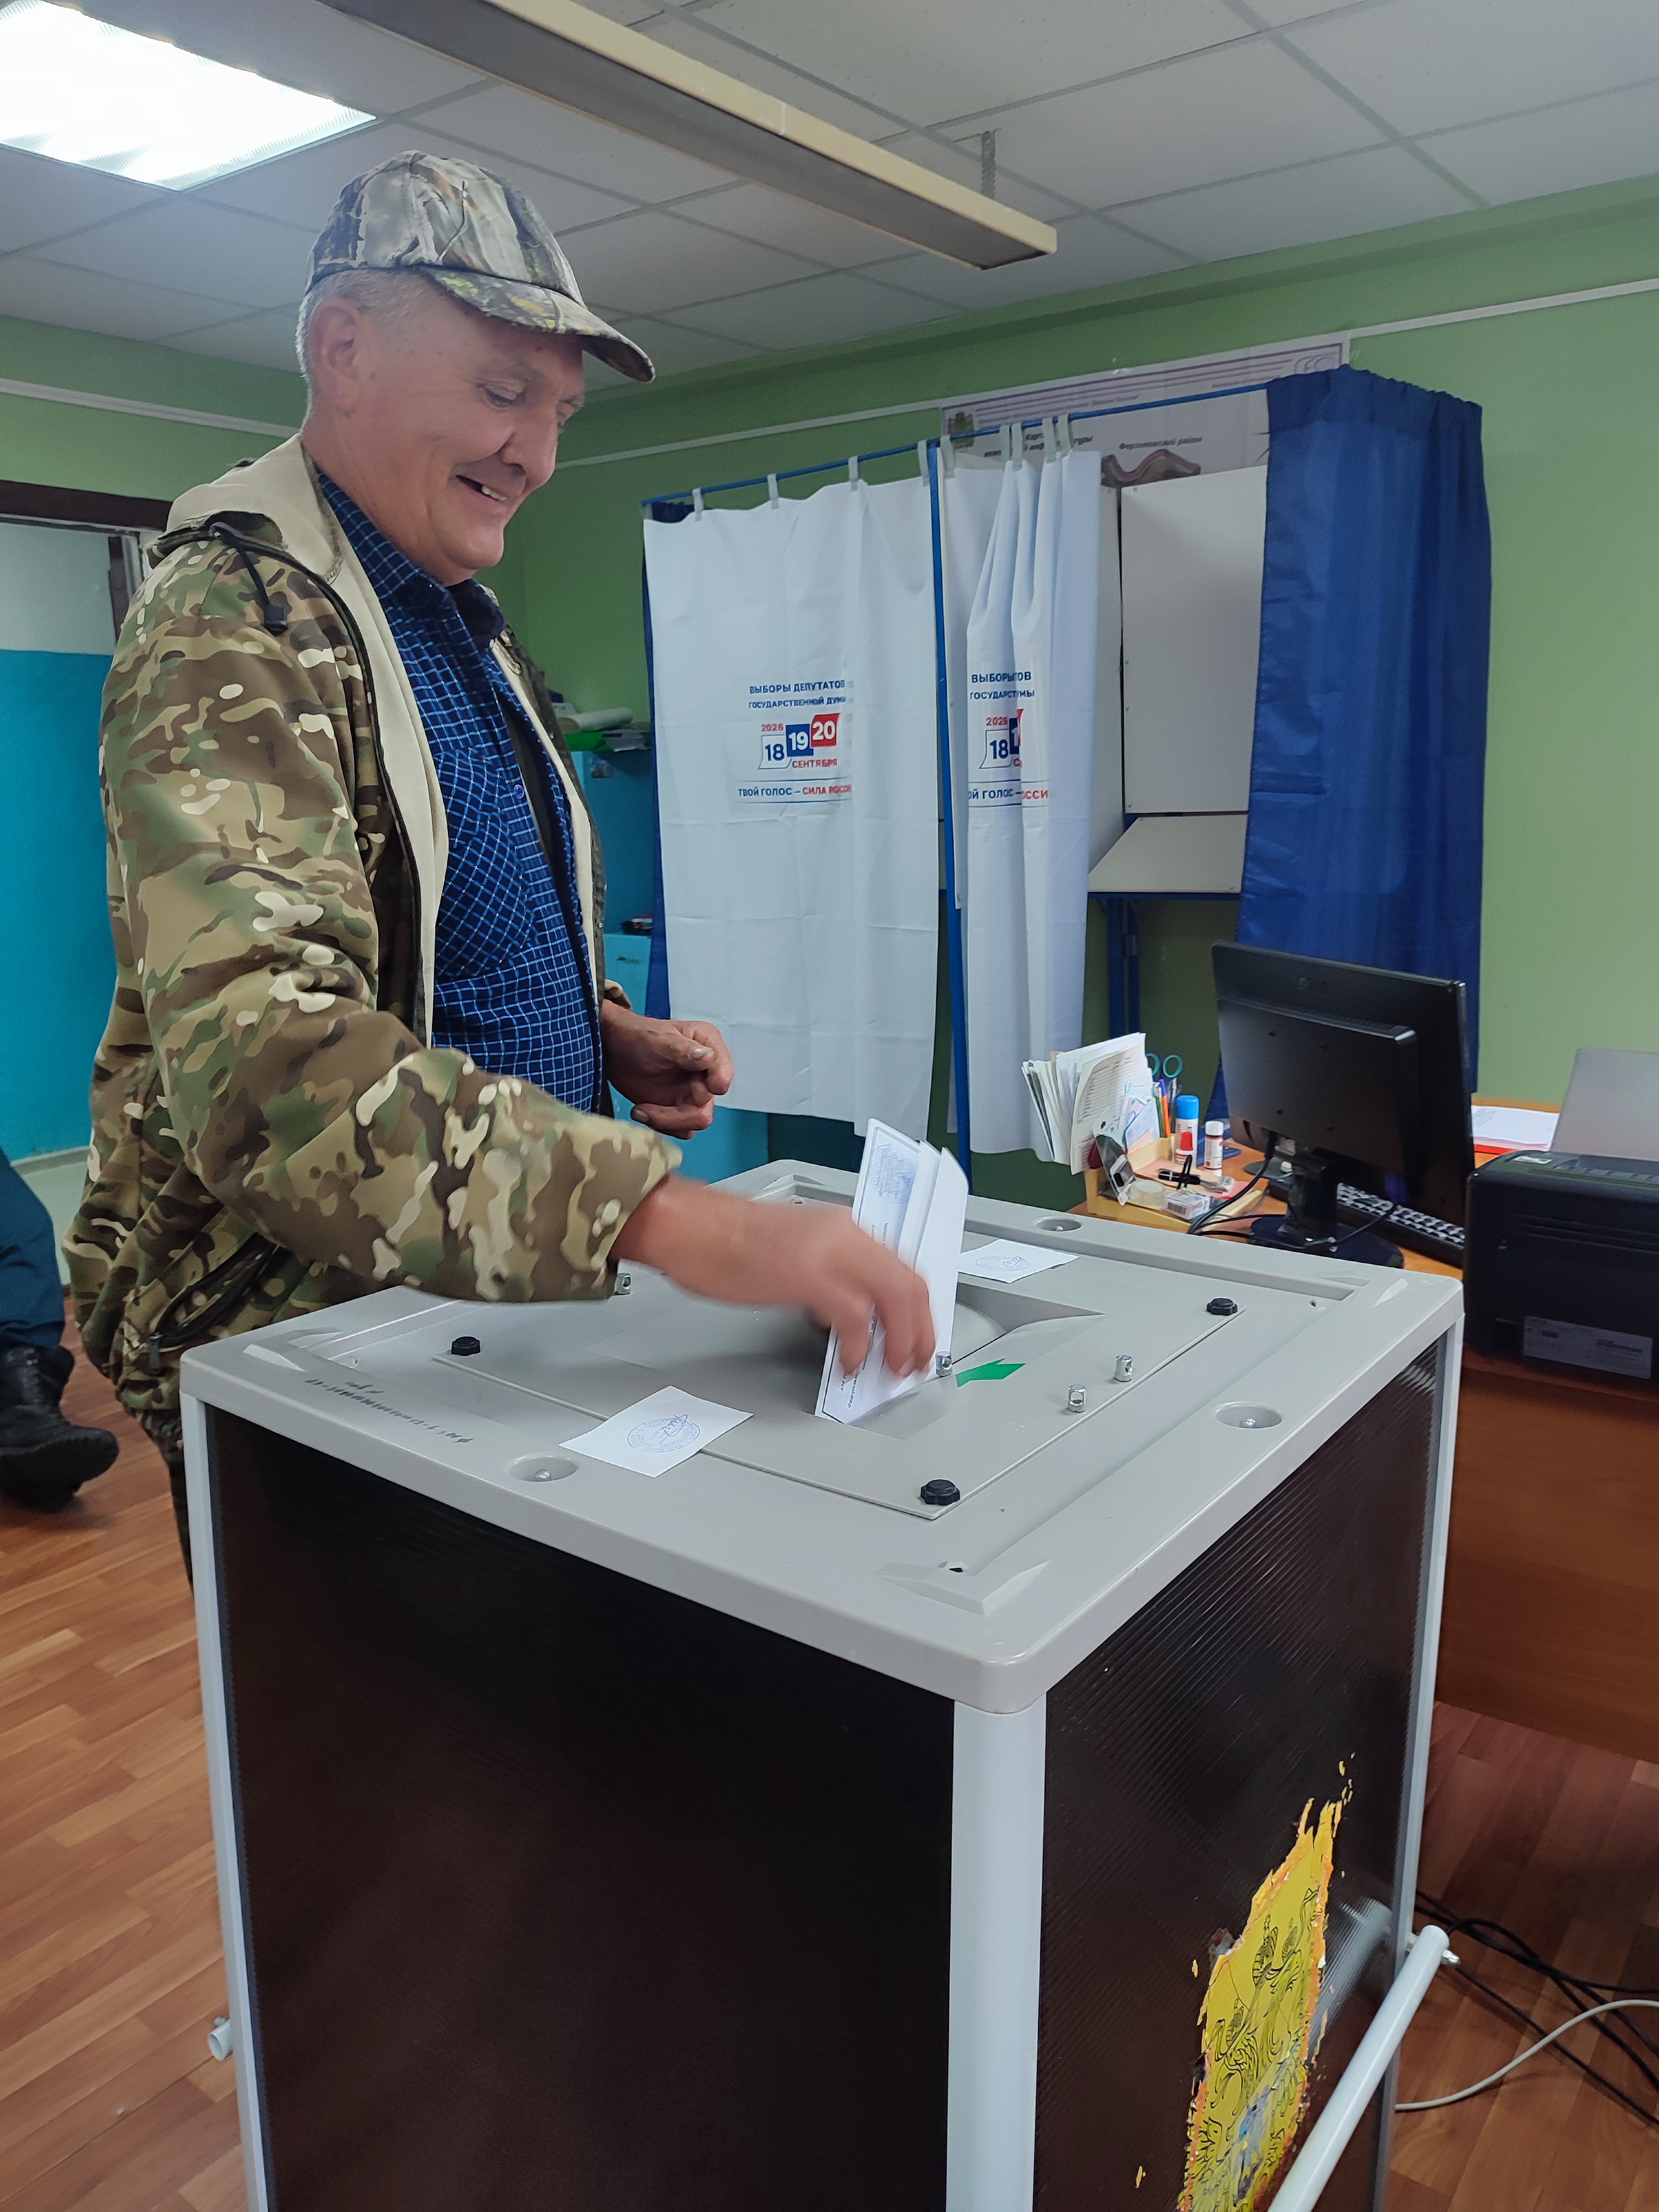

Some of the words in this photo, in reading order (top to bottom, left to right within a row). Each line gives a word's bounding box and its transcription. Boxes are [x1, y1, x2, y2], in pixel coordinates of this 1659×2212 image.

[749, 684, 791, 694] ВЫБОРЫ
[794, 680, 845, 693] ДЕПУТАТОВ
[749, 697, 824, 709] ГОСУДАРСТВЕННОЙ
[986, 717, 1008, 726] 2026
[761, 723, 784, 732] 2026
[765, 744, 785, 761] 18
[789, 731, 808, 750] 19
[812, 721, 836, 740] 20
[990, 739, 1009, 759] 18
[792, 759, 838, 769] СЕНТЯБРЯ
[738, 786, 759, 796] ТВОЙ
[761, 787, 792, 796] ГОЛОС
[803, 786, 827, 795] СИЛА
[983, 788, 1014, 799] ГОЛОС
